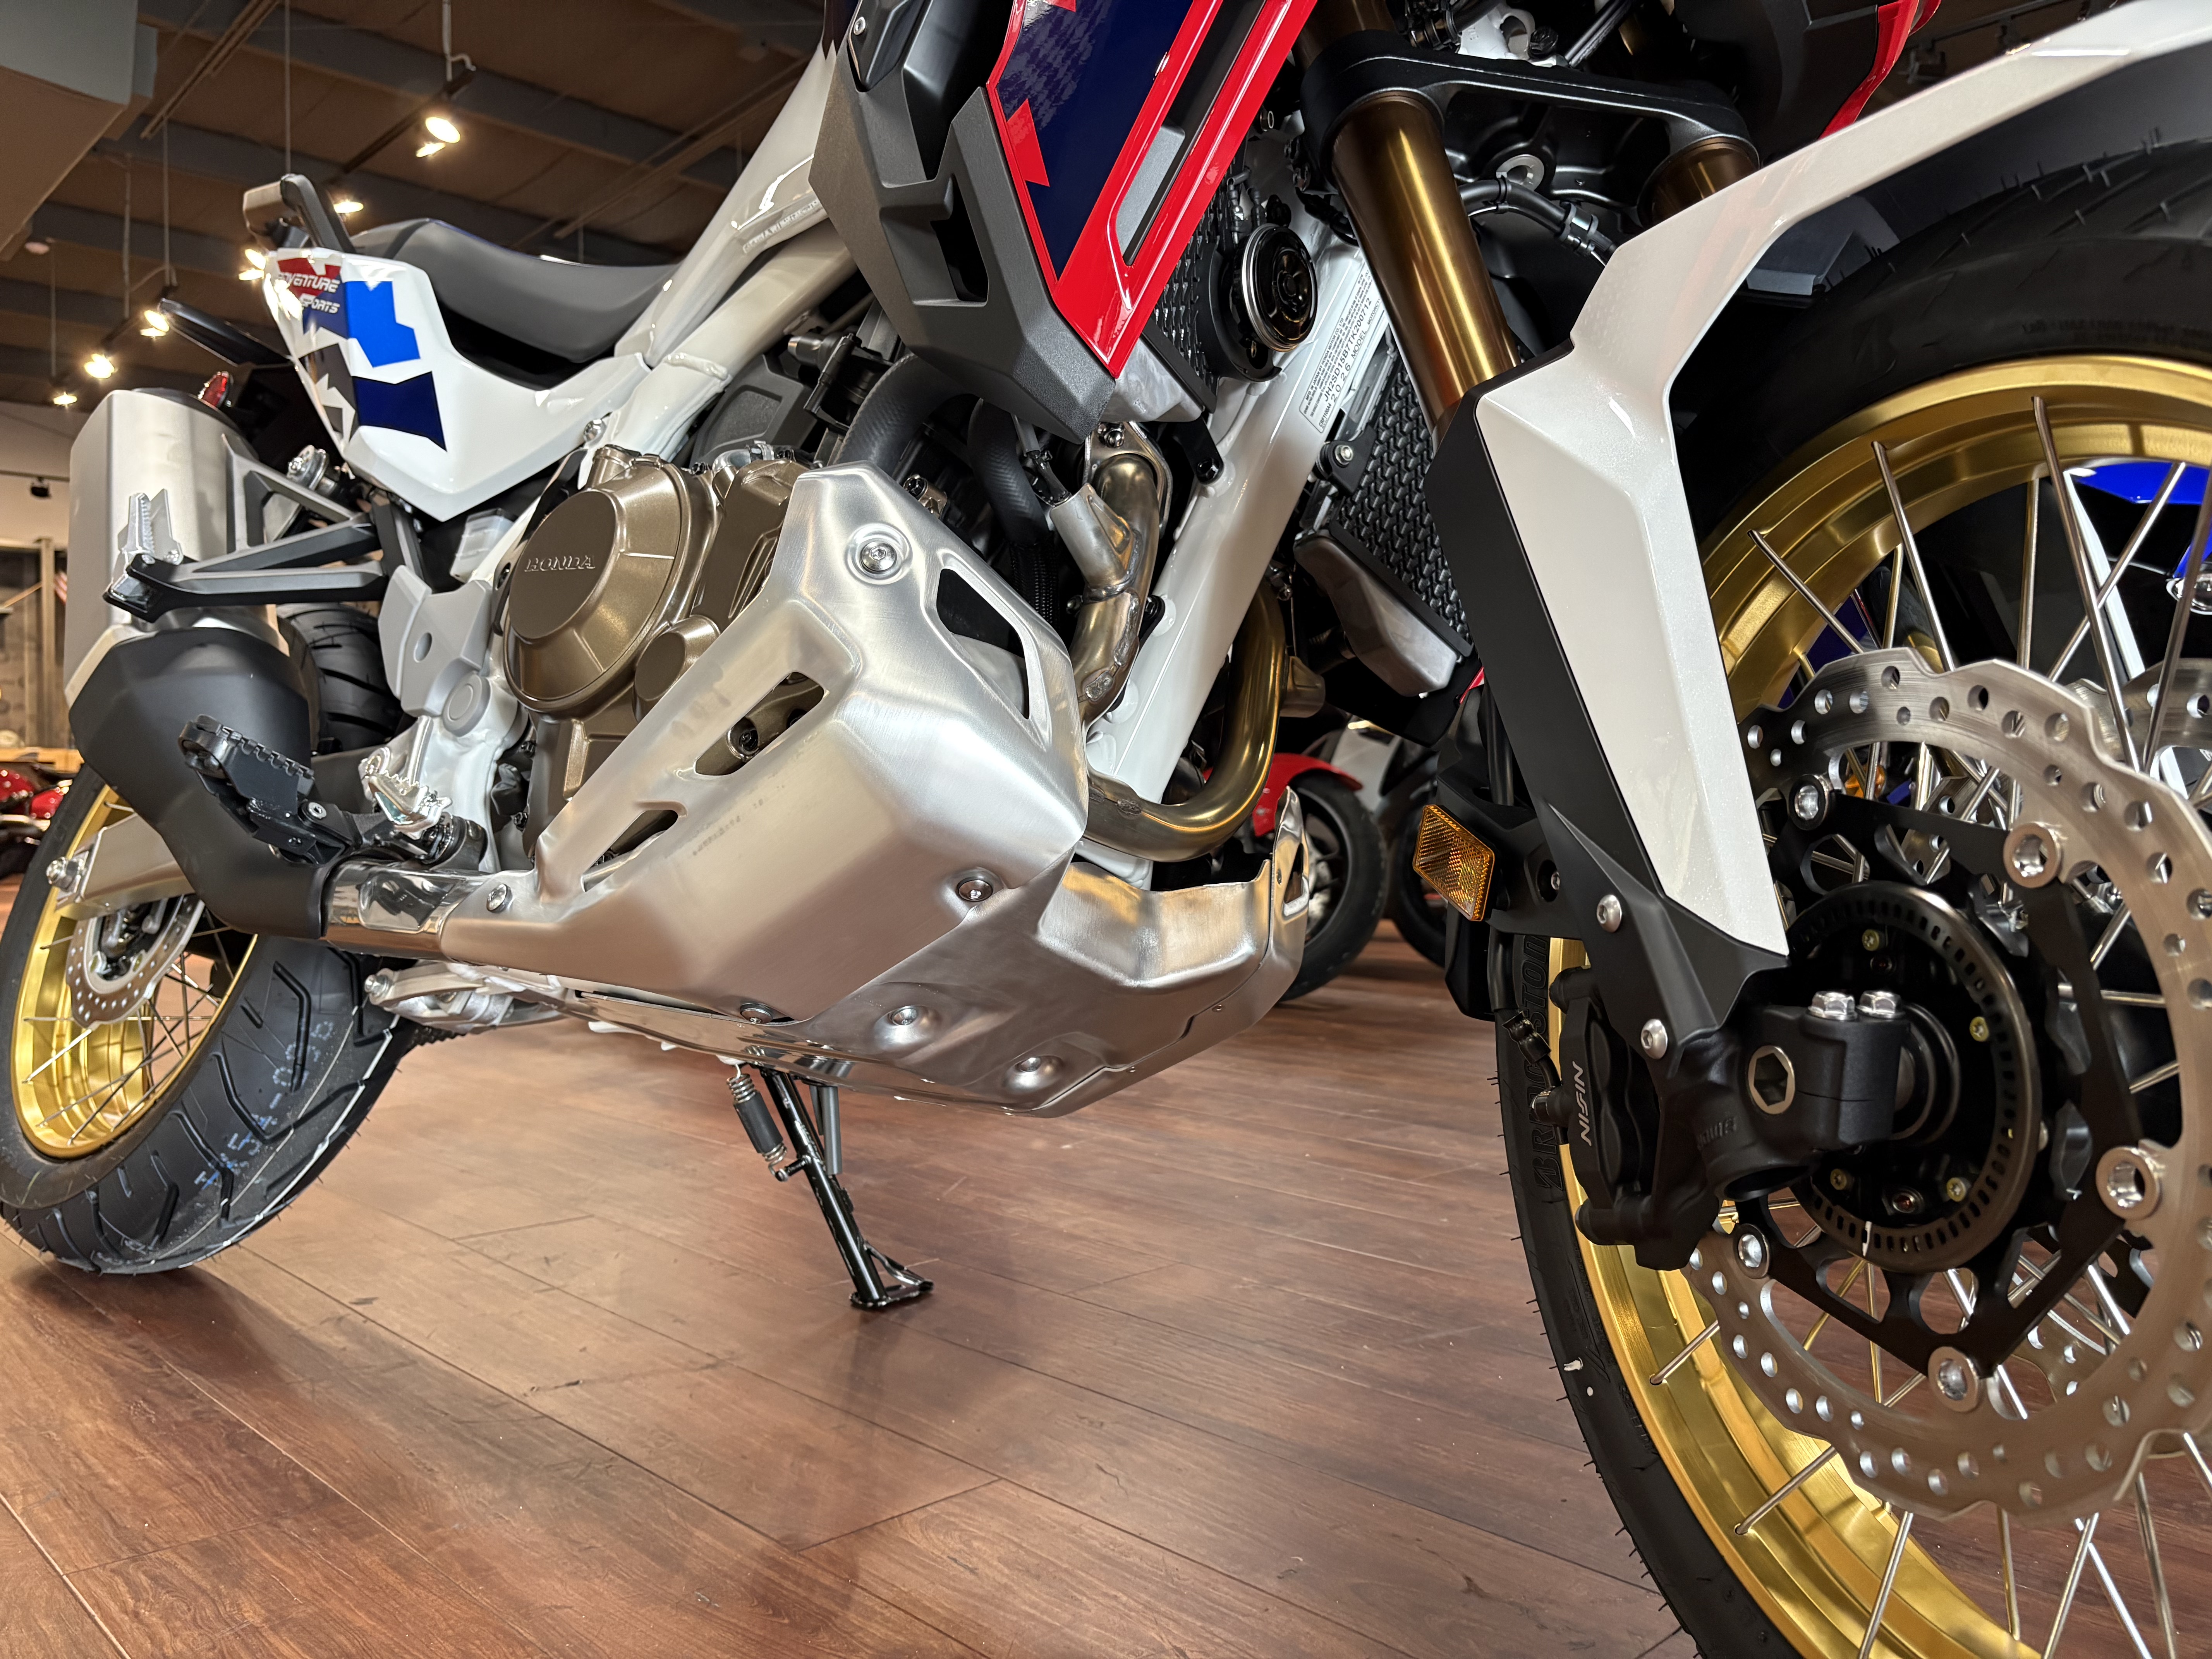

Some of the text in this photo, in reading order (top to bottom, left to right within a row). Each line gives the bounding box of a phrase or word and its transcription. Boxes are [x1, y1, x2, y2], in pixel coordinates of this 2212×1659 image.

[299, 293, 340, 314] SPORTS
[1351, 330, 1367, 359] MODEL
[1367, 299, 1380, 325] MOTORCY
[1321, 350, 1330, 365] HONDA
[1324, 297, 1371, 402] JH2SD15B7TK200712
[524, 555, 596, 572] HONDA
[1572, 1061, 1592, 1147] NISSIN
